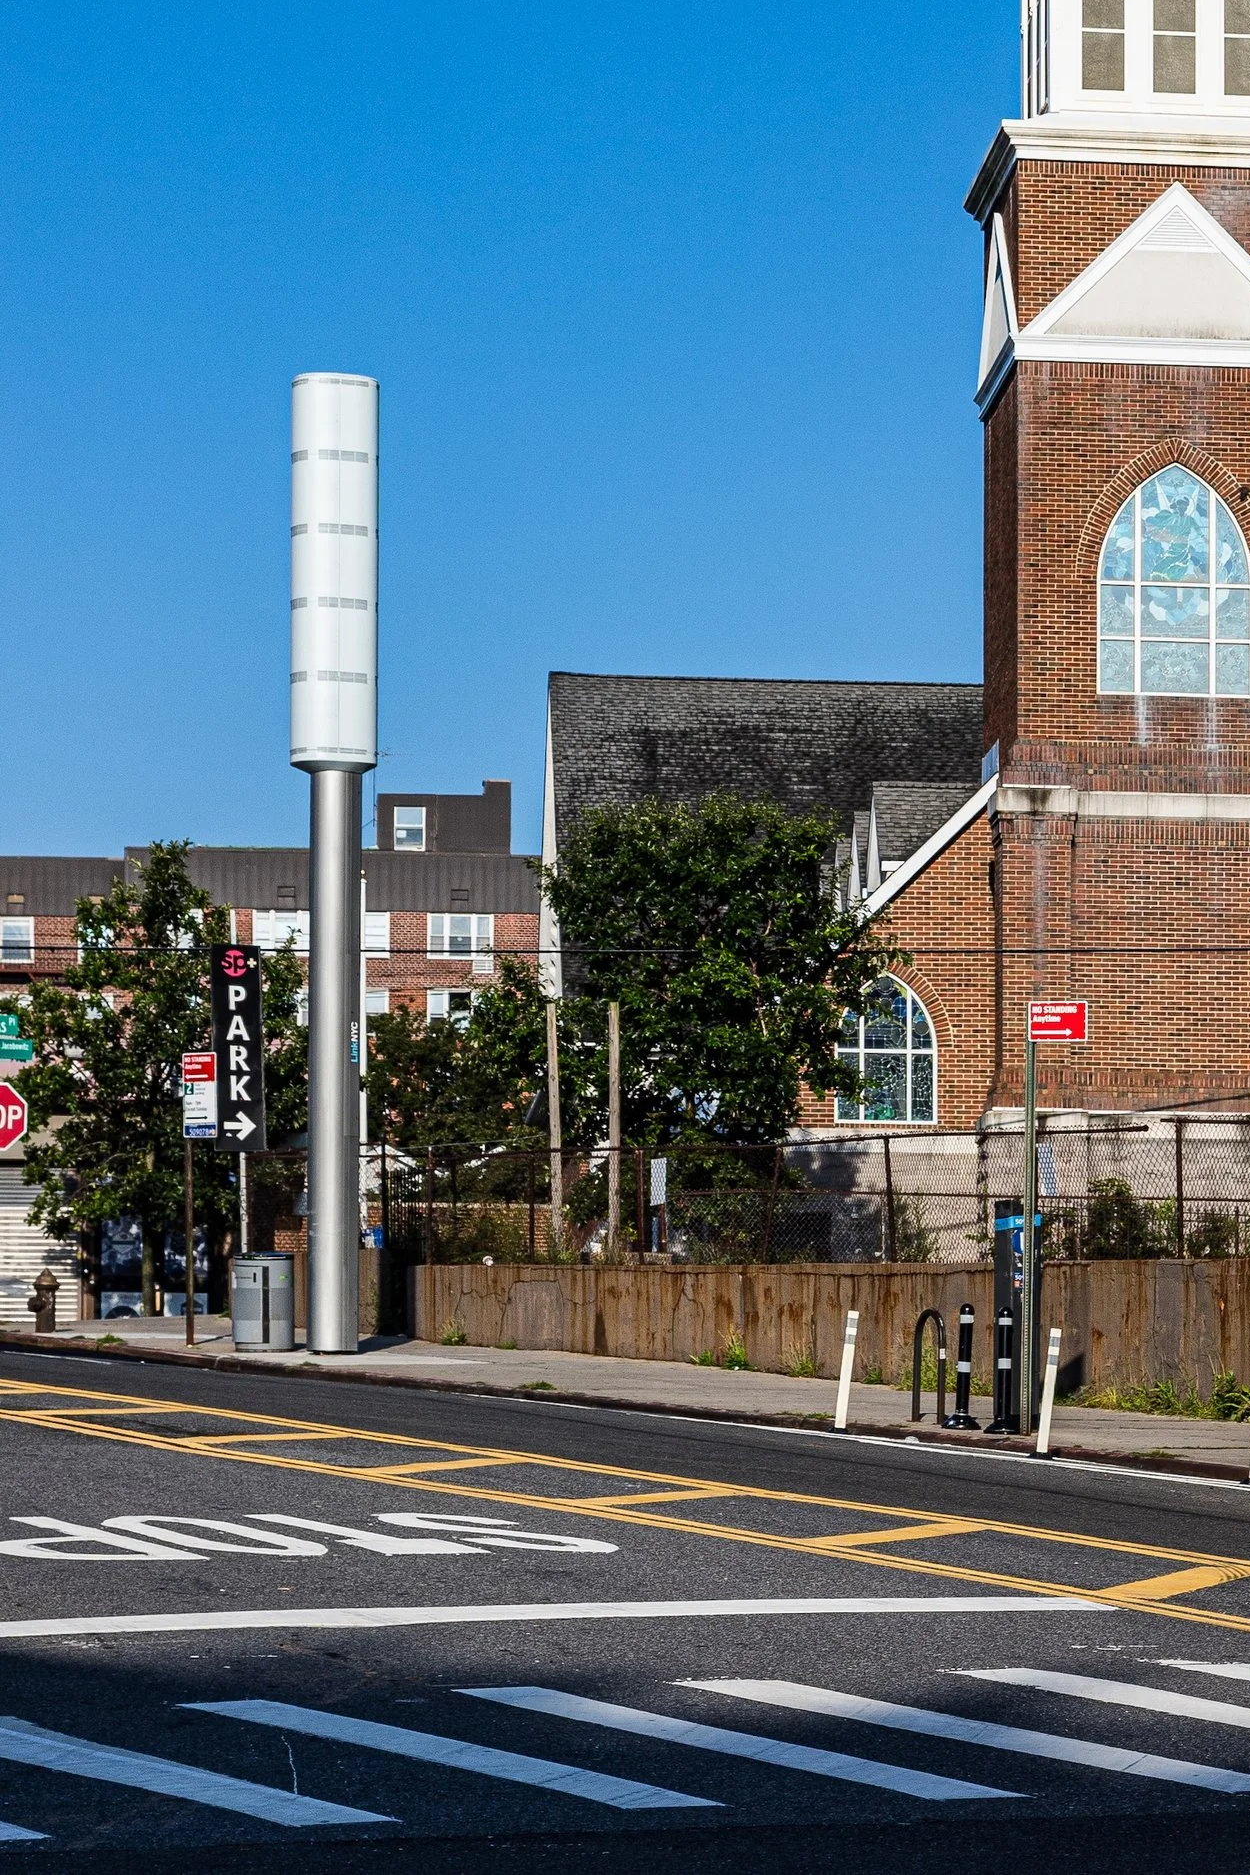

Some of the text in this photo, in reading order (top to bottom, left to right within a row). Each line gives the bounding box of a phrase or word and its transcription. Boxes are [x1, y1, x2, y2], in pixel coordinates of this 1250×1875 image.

[1032, 1015, 1061, 1024] Anytime
[226, 985, 252, 1101] PARK
[350, 1021, 359, 1063] LinkNYC
[186, 1082, 192, 1094] 2
